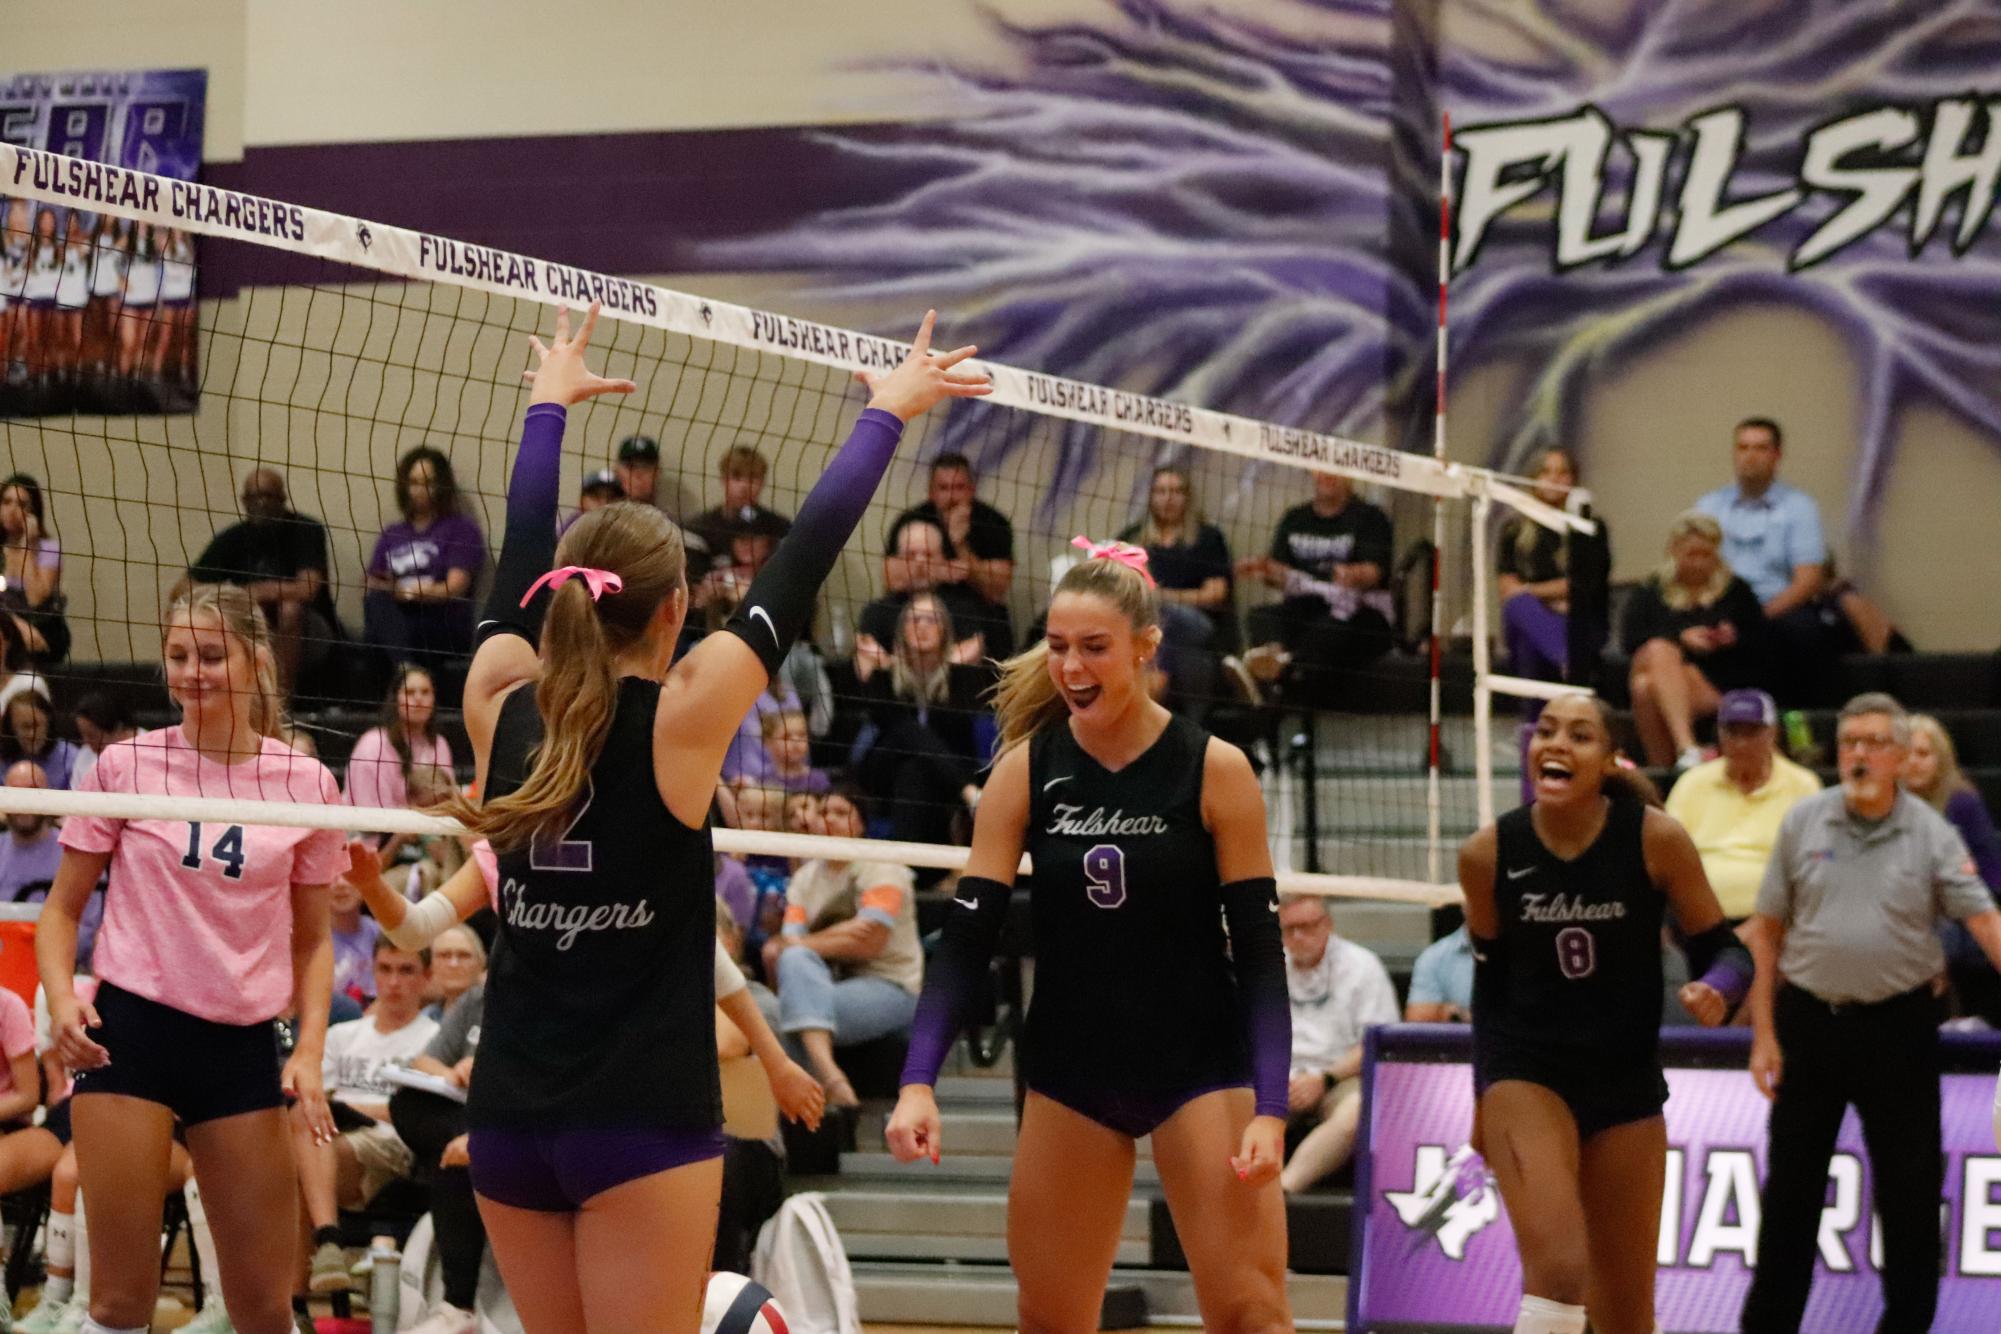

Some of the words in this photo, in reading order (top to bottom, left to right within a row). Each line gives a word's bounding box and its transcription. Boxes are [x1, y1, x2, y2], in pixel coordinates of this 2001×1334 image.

[14, 148, 160, 213] FULSHEAR
[171, 181, 304, 242] CHARGERS
[419, 235, 538, 292] FULSHEAR
[546, 262, 657, 318] CHARGERS
[752, 312, 853, 361] FULSHEAR
[1027, 375, 1107, 416] FULSHEAR
[1114, 392, 1192, 433] CHARGERS
[1260, 425, 1329, 462] FULSHEAR
[1333, 444, 1400, 478] CHARGERS
[1046, 803, 1168, 836] Fulshear
[181, 821, 246, 880] 14
[1083, 844, 1127, 909] 9
[503, 877, 656, 951] Chargers
[1520, 892, 1627, 923] Fulshear
[1555, 927, 1595, 980] 8
